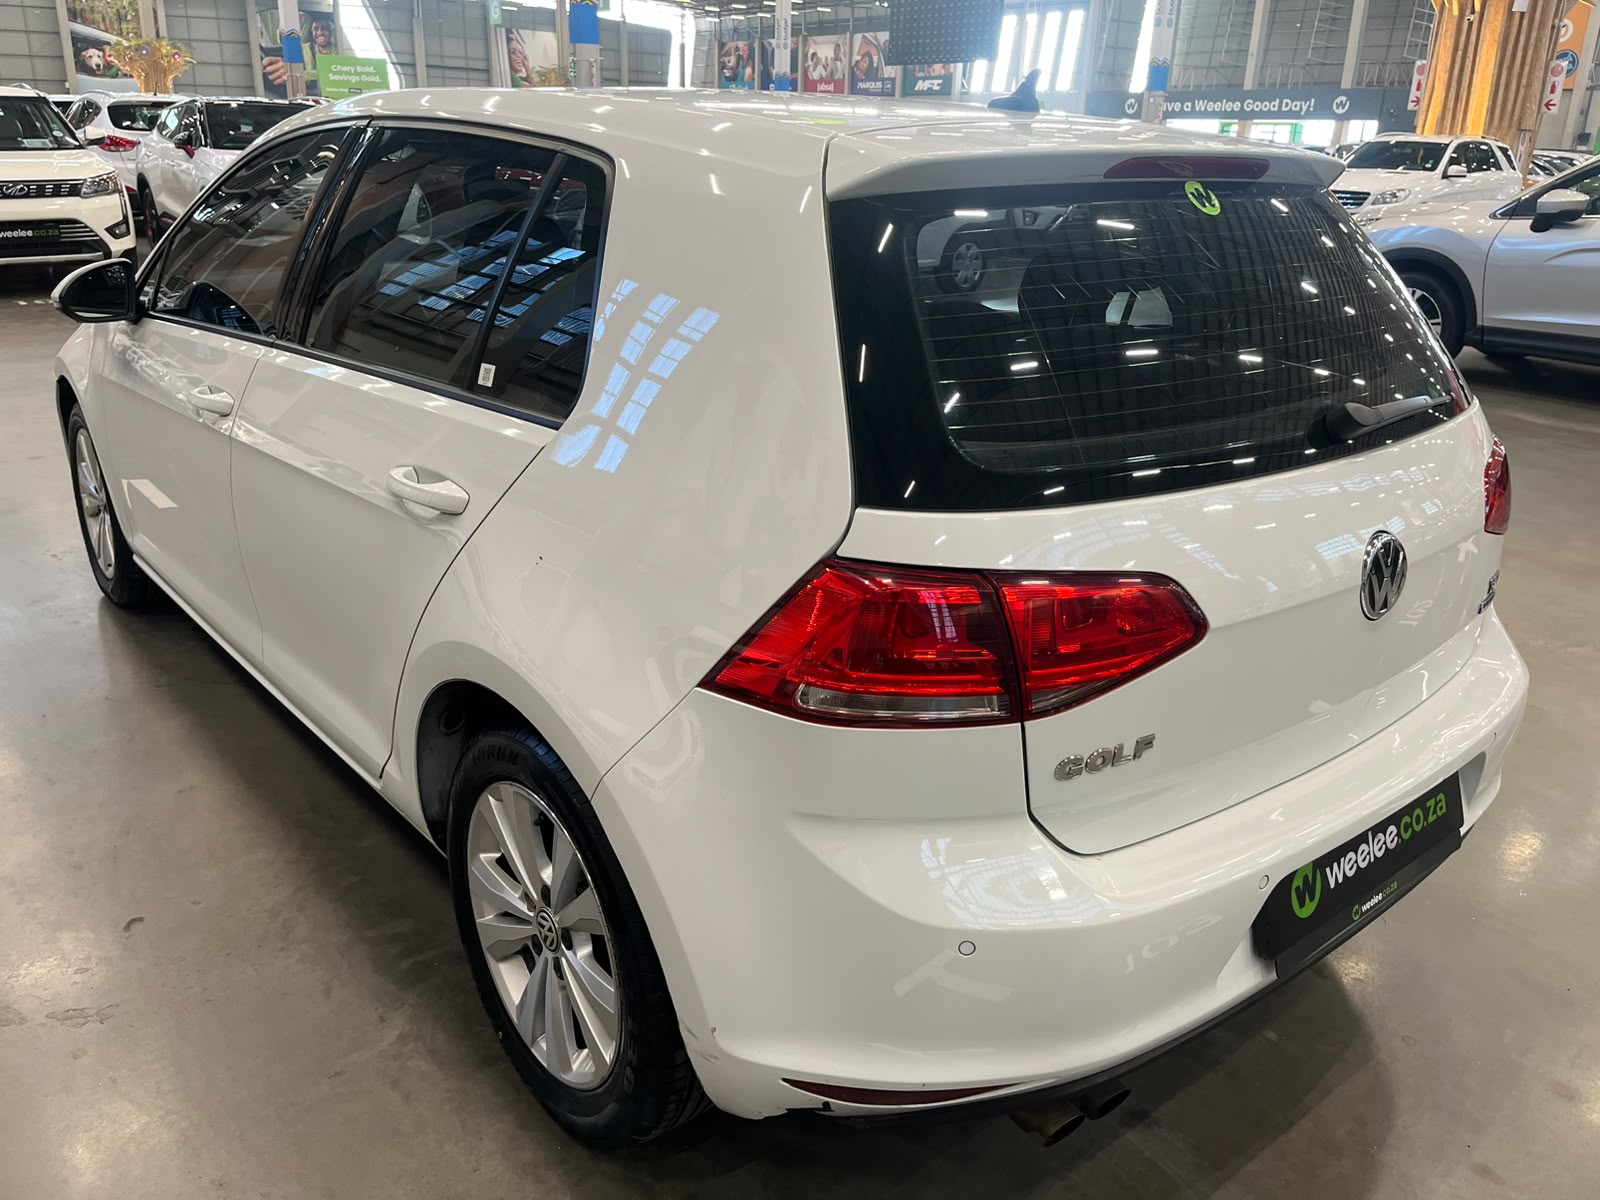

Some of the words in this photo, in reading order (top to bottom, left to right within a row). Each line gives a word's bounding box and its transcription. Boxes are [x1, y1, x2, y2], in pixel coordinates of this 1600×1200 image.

[328, 73, 360, 83] Savings
[331, 65, 355, 74] Chery
[913, 80, 943, 92] MFC
[1183, 101, 1192, 112] a
[1195, 99, 1241, 112] Weelee
[1244, 99, 1280, 112] Good
[1282, 98, 1315, 116] Day!
[1053, 733, 1157, 782] GOLF
[1326, 793, 1447, 890] weelee.co.za
[1361, 882, 1398, 913] weelee.co.za
